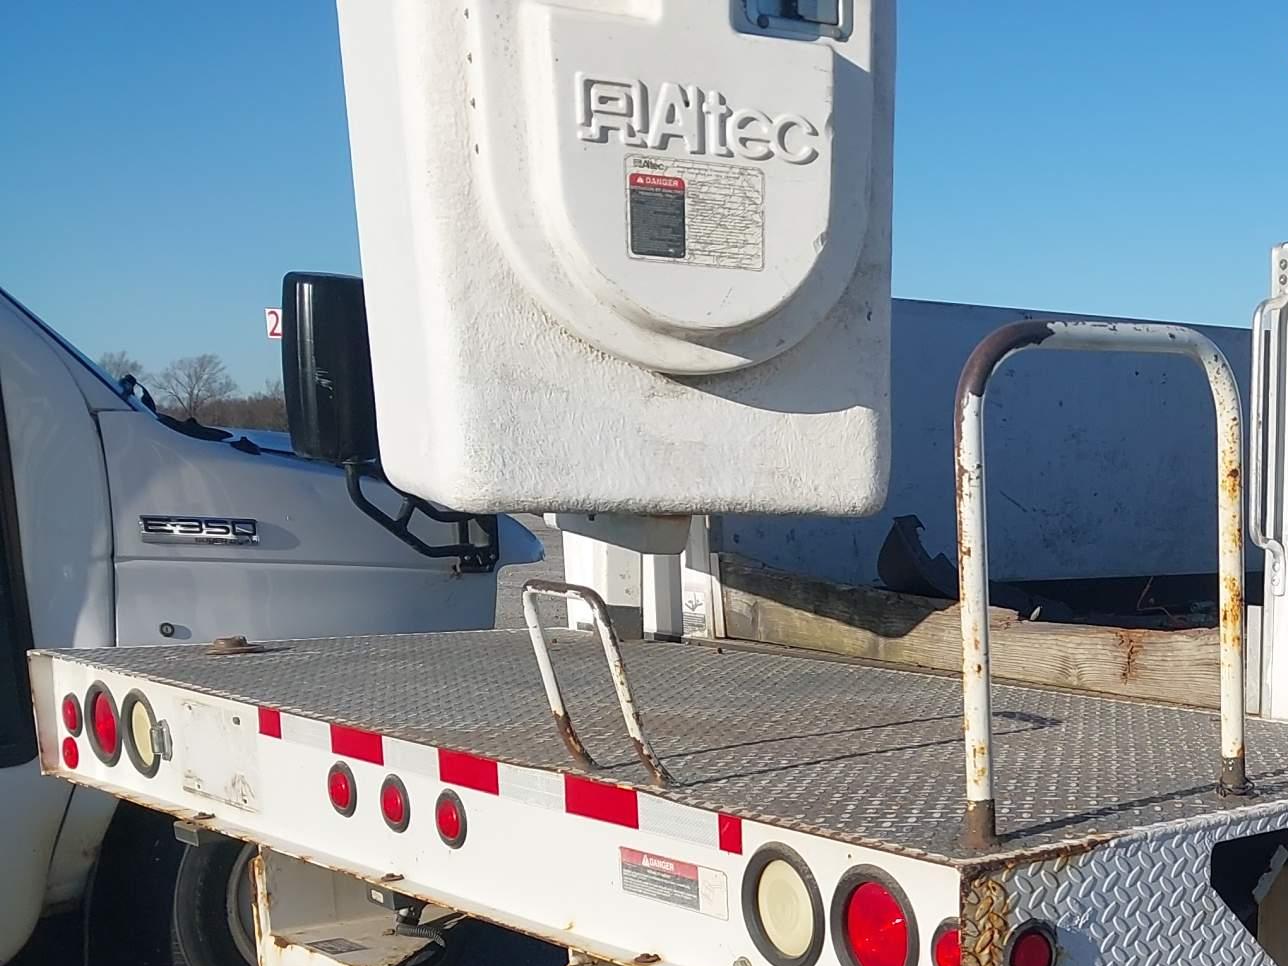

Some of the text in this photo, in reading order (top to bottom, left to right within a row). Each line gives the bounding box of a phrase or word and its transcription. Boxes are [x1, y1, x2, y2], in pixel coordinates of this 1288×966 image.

[648, 82, 820, 165] Altec
[645, 177, 679, 187] DANGER
[649, 857, 675, 872] DANGER
